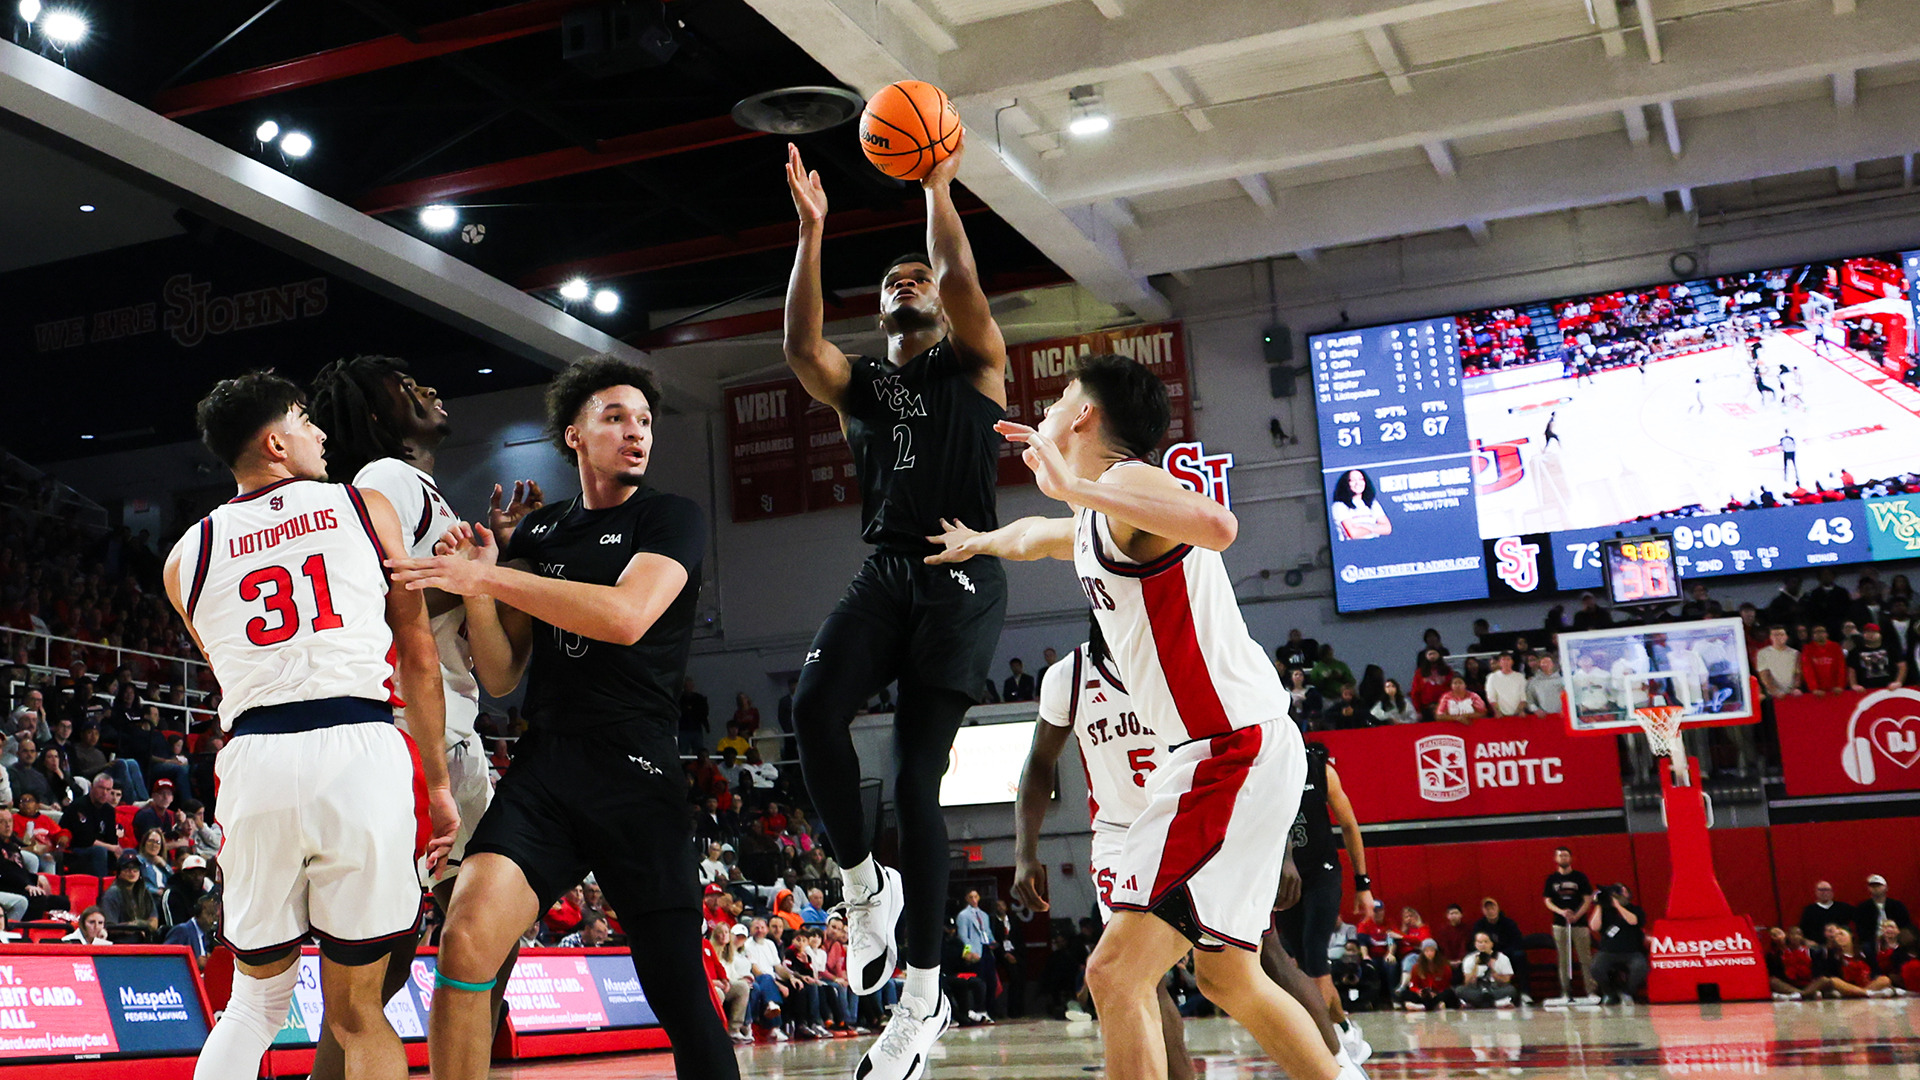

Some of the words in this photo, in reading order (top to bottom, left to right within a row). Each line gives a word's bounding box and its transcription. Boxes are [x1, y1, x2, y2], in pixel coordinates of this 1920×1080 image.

[36, 317, 83, 351] WE
[91, 303, 156, 342] ARE
[1112, 332, 1174, 366] WNIT
[1327, 336, 1362, 348] PLAYER
[1031, 343, 1092, 380] NCAA
[1394, 352, 1402, 361] 0
[1411, 350, 1419, 359] 0
[1428, 347, 1436, 356] 0
[1445, 345, 1453, 354] 0
[1430, 358, 1438, 367] 0
[1449, 377, 1457, 386] 0
[734, 389, 788, 424] WBIT
[1374, 405, 1408, 419] 3PT%
[1421, 400, 1448, 413] FT%
[1338, 427, 1362, 447] 51
[1379, 421, 1407, 442] 23
[1422, 415, 1449, 437] 67
[734, 437, 794, 457] APPEARANCES
[893, 424, 916, 471] 2
[229, 508, 338, 559] LIOTOPOULOS
[599, 533, 623, 545] CAA
[1673, 521, 1740, 551] 9:06
[1807, 517, 1854, 545] 43
[1620, 540, 1670, 562] 9:06
[1377, 562, 1416, 577] STREET
[1416, 557, 1480, 573] RADIOLOGY
[1695, 559, 1723, 572] 2ND
[239, 553, 344, 646] 31
[1087, 717, 1113, 746] ST.
[1474, 739, 1529, 759] ARMY
[1127, 747, 1157, 787] 5
[1474, 757, 1563, 788] ROTC
[1650, 932, 1752, 958] Maspeth
[521, 962, 549, 978] CITY.
[1652, 960, 1704, 969] FEDERAL
[1704, 957, 1756, 967] SAVINGS
[505, 979, 528, 994] OUR
[527, 978, 555, 993] DEBIT
[553, 977, 584, 993] CARD.
[603, 977, 641, 996] Maspeth
[29, 986, 83, 1006] CARD.
[119, 985, 183, 1011] Maspeth
[532, 994, 561, 1009] CALL.
[124, 1012, 157, 1022] FEDERAL
[157, 1010, 188, 1021] SAVINGS
[396, 1019, 405, 1034] 8
